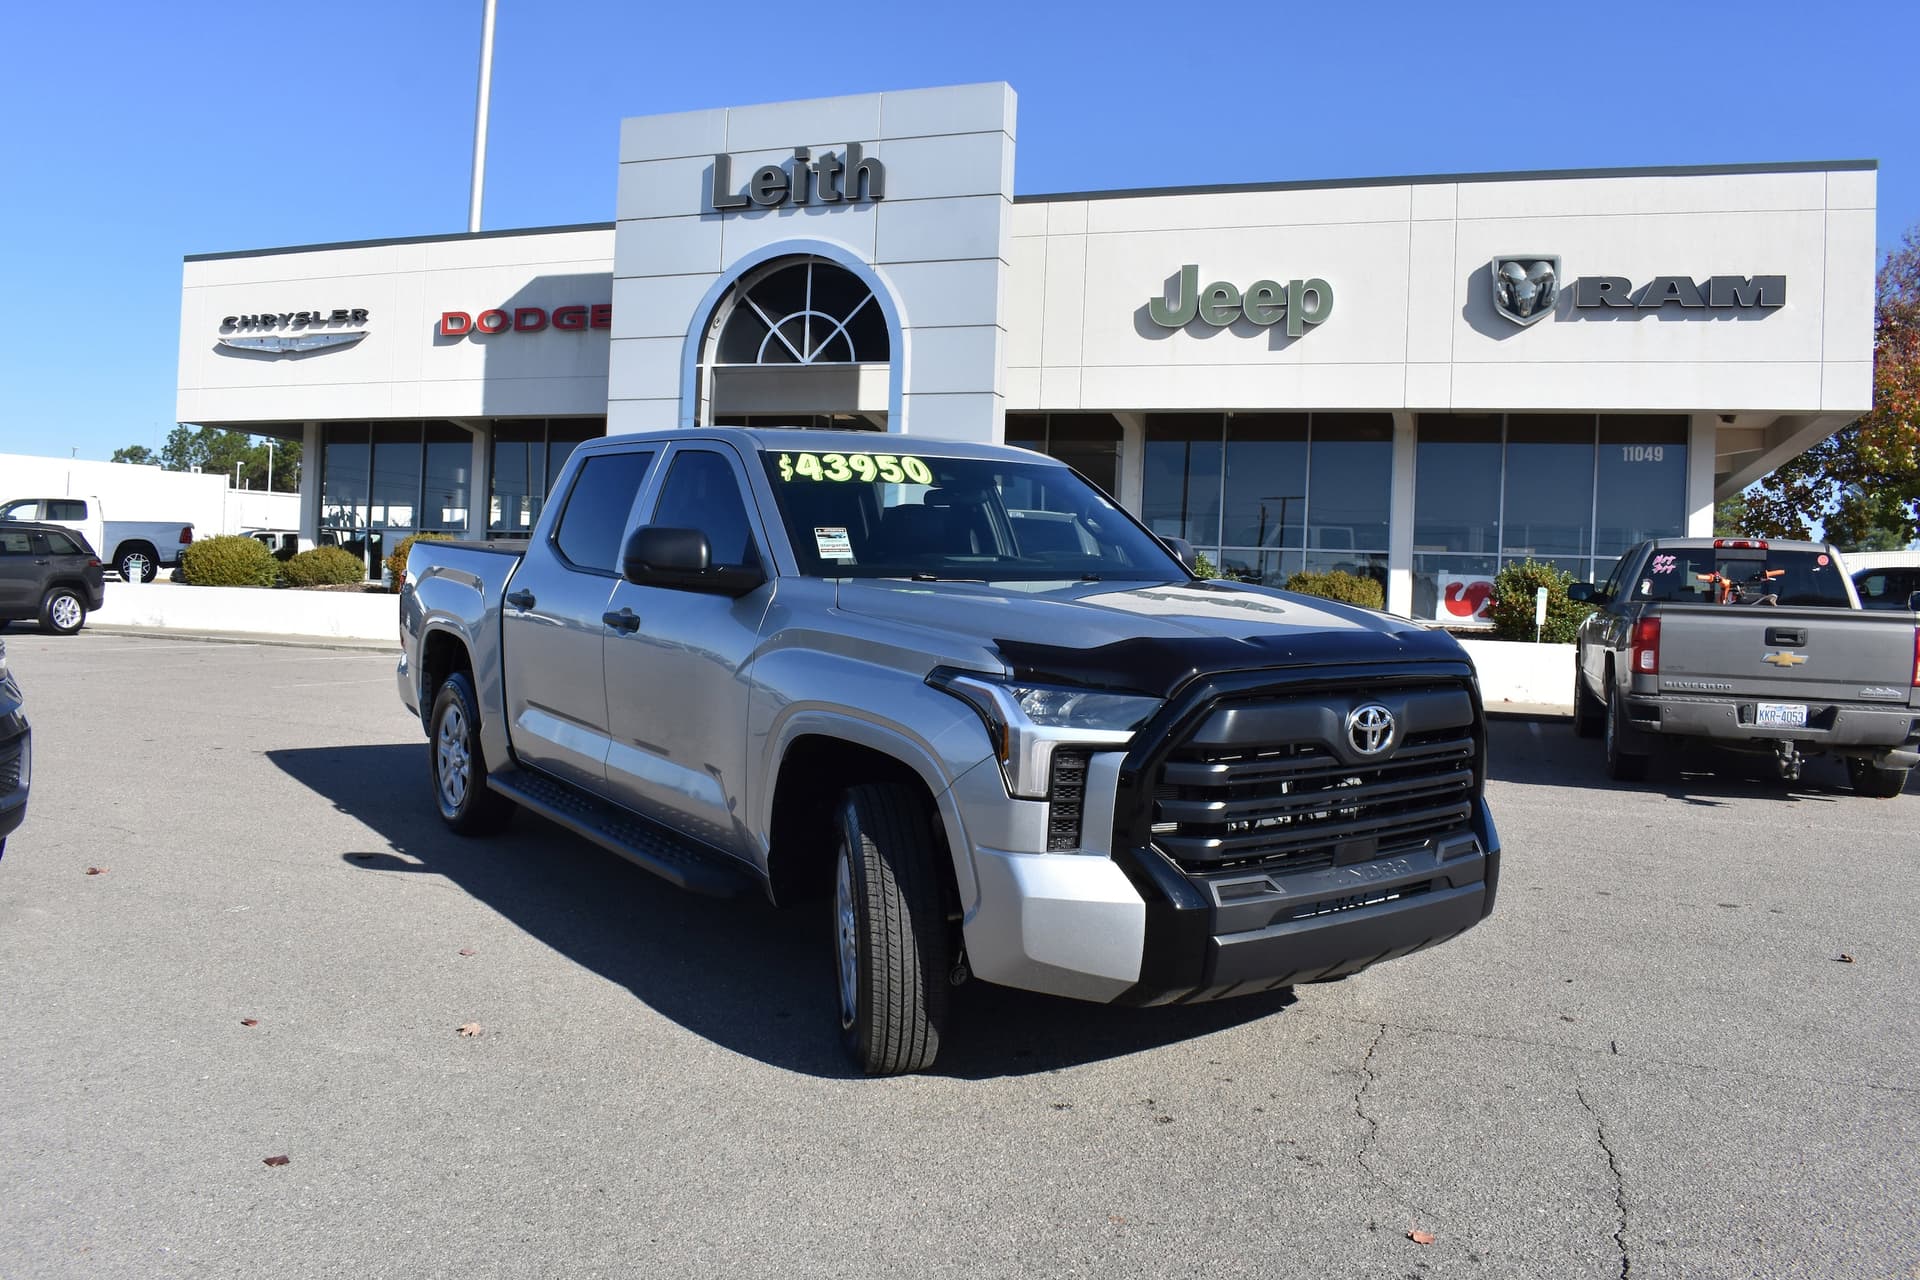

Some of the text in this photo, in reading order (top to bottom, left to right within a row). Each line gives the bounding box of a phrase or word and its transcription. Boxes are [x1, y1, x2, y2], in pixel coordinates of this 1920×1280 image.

[711, 142, 886, 209] Leith
[1149, 264, 1334, 337] Jeep
[1576, 275, 1787, 307] RAM
[222, 308, 370, 330] CHRYSLER
[440, 303, 612, 337] DODGE
[778, 453, 933, 485] $43950
[1622, 446, 1664, 462] 11049
[1759, 709, 1804, 723] KKR-4053
